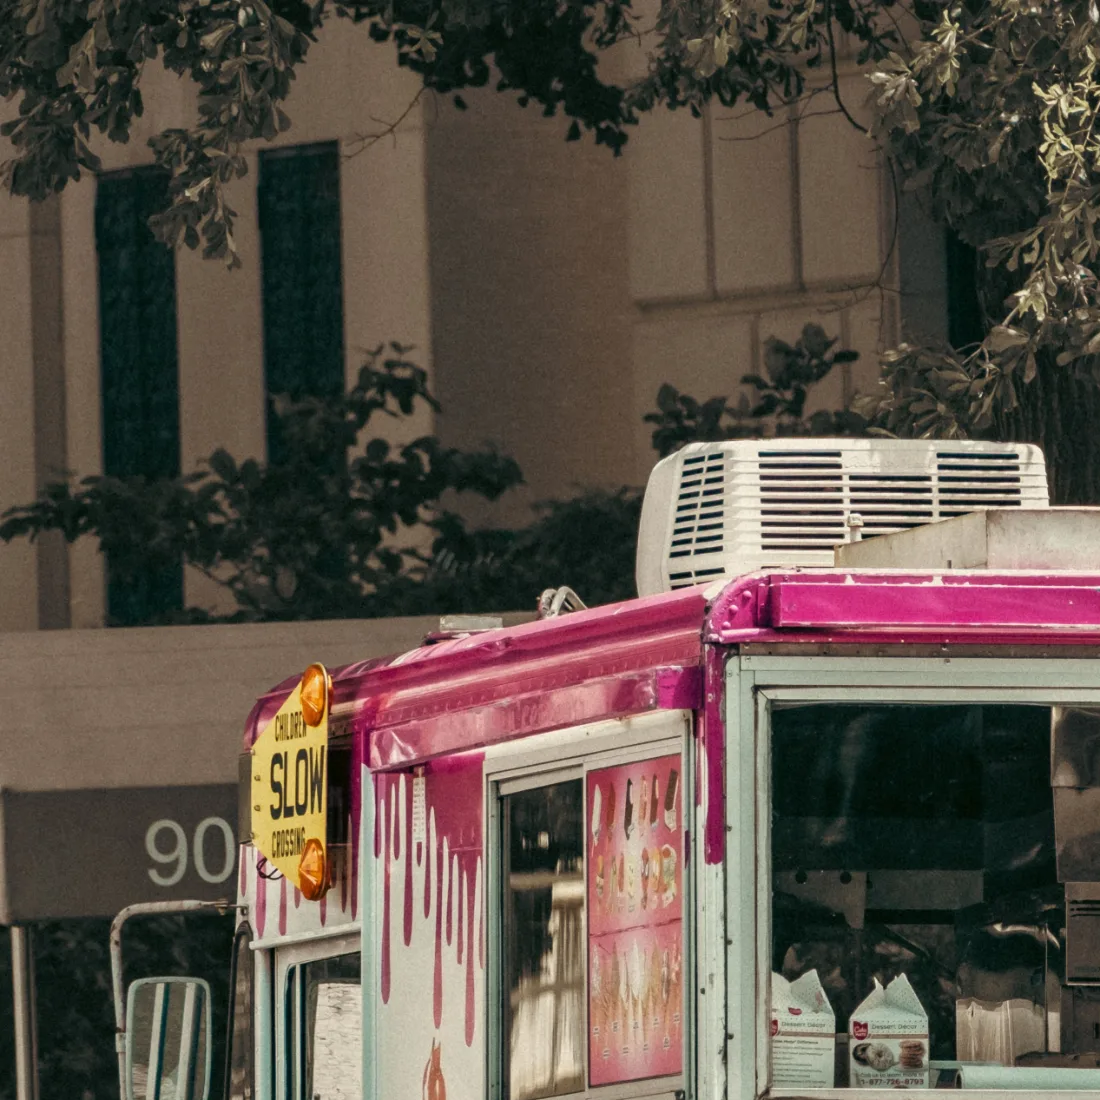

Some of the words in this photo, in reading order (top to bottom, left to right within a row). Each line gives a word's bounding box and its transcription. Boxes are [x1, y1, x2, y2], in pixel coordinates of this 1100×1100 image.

[275, 711, 307, 742] CHILDREN
[270, 745, 325, 820] SLOW
[145, 817, 235, 887] 90
